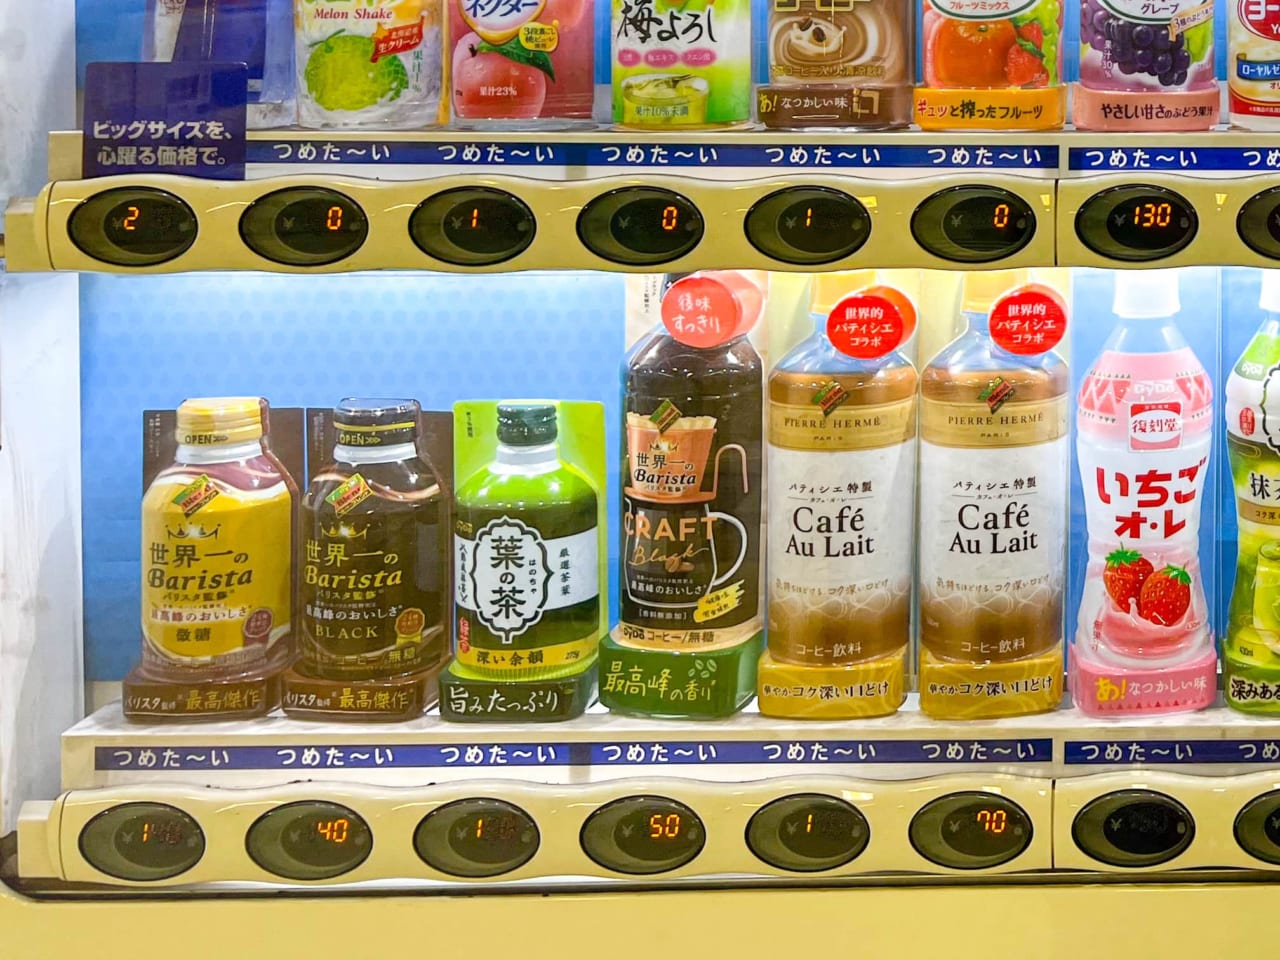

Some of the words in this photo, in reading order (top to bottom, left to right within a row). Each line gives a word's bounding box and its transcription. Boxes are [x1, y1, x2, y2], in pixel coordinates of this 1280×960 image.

[314, 8, 348, 20] Melon
[355, 8, 392, 20] Shake
[949, 1, 1010, 10] フルーツミックス
[1141, 4, 1180, 15] グレープ
[437, 144, 554, 163] つめた〜い
[764, 146, 881, 165] つめた〜い
[326, 206, 343, 230] 0
[1133, 203, 1171, 228] 130
[845, 305, 884, 320] 世界的
[1007, 301, 1047, 318] 世界的
[672, 313, 721, 334] すっきり
[835, 322, 894, 335] パティシエ
[997, 319, 1056, 332] パティシエ
[849, 334, 882, 348] コラボ
[1012, 331, 1045, 345] コラボ
[1131, 417, 1181, 434] 復刻堂
[185, 434, 212, 445] OPEN
[339, 433, 365, 445] OPEN
[633, 468, 697, 487] Barista
[1096, 458, 1207, 504] いちご
[793, 506, 864, 533] Café
[958, 502, 1030, 530] Café
[624, 516, 717, 542] CRAFT
[785, 534, 814, 556] Au
[824, 535, 874, 558] Lait
[949, 532, 981, 554] Au
[991, 530, 1038, 554] Lait
[150, 542, 249, 566] 世界一の
[305, 541, 399, 566] 世界一の
[148, 565, 253, 590] Barista
[303, 565, 403, 589] Barista
[490, 535, 526, 621] 葉の茶
[315, 623, 379, 640] BLACK
[798, 643, 861, 657] コーヒー飲料
[961, 638, 1025, 653] コーヒー飲料
[186, 688, 261, 710] 最高傑作
[449, 687, 560, 714] 旨みたっぷり
[602, 743, 717, 762] つめた〜い
[317, 819, 349, 842] 40
[650, 814, 680, 837] 50
